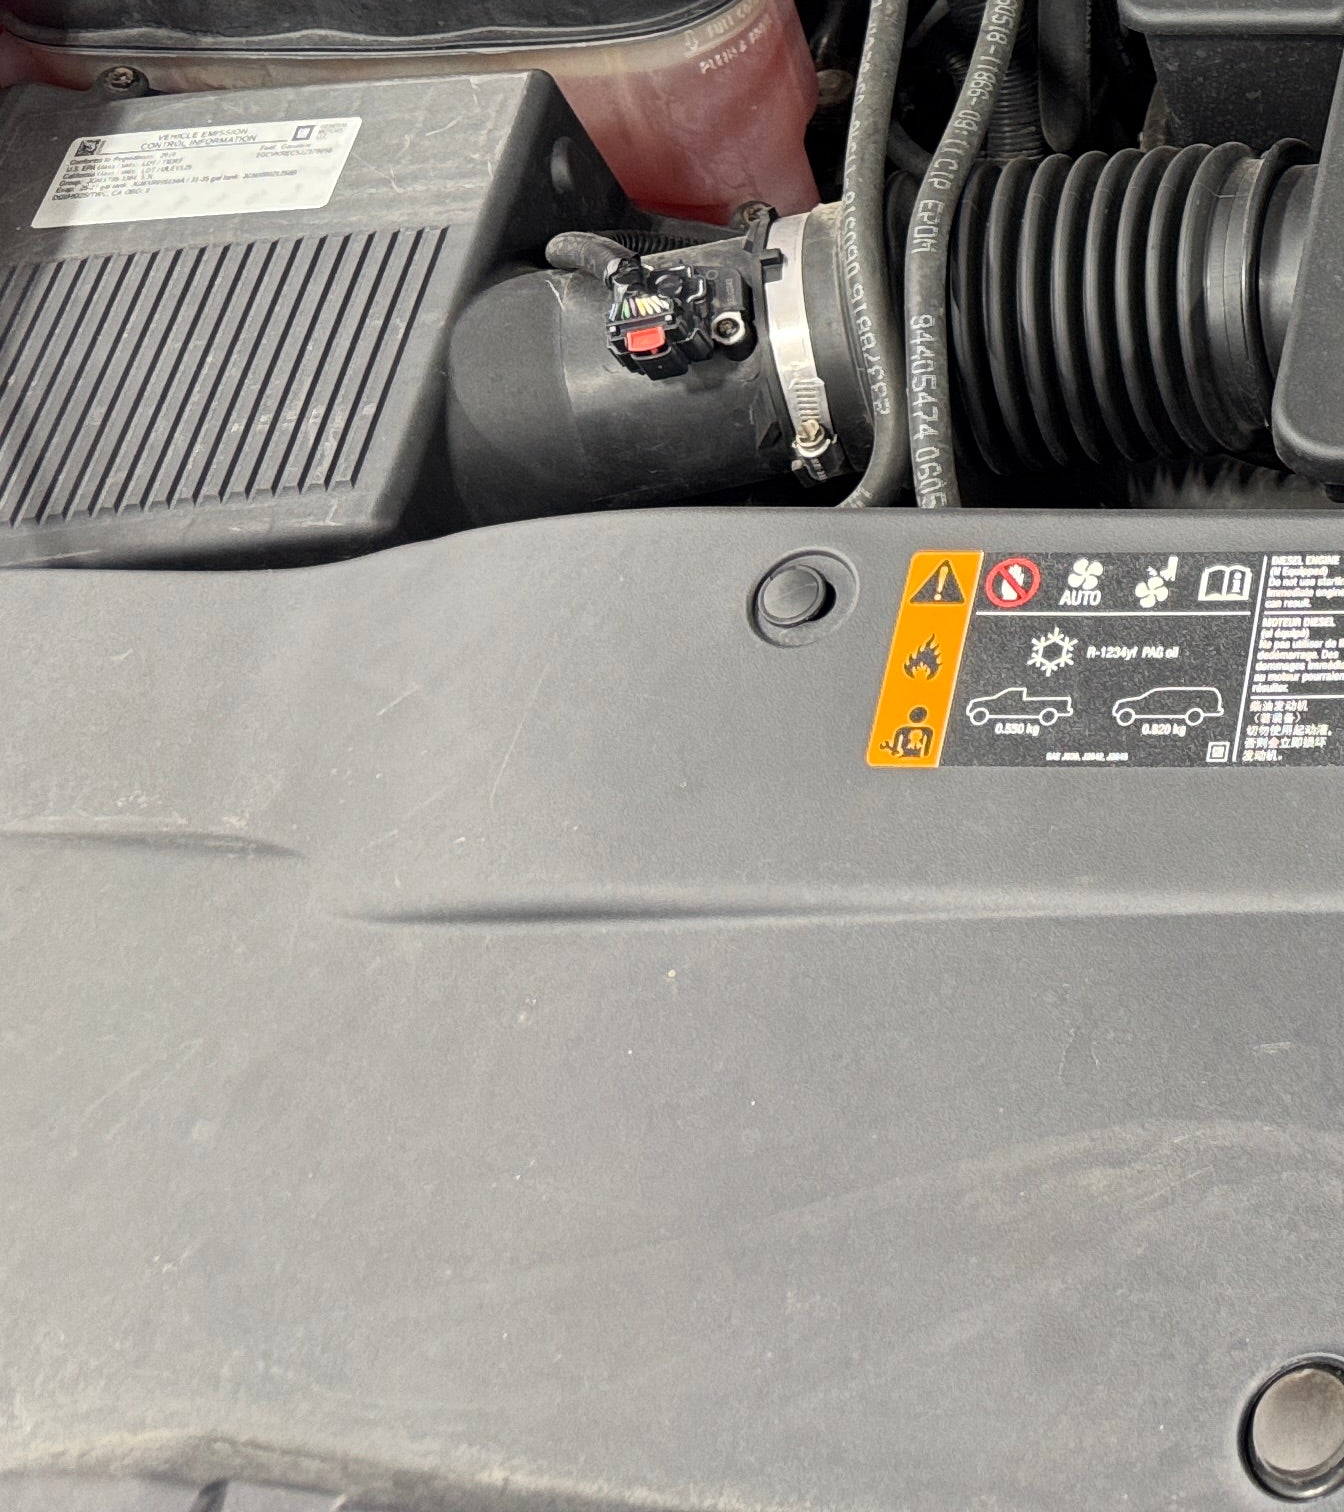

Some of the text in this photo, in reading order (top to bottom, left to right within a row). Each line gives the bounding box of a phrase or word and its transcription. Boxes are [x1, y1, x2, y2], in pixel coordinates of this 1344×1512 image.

[1271, 555, 1304, 565] DIESEL
[1282, 577, 1298, 586] not
[1059, 589, 1102, 606] AUTO
[1262, 616, 1336, 627] MOTEUR DIESEL
[1086, 646, 1180, 661] R-1234yf PAG oil
[1026, 723, 1041, 737] kg
[1173, 724, 1187, 737] kg
